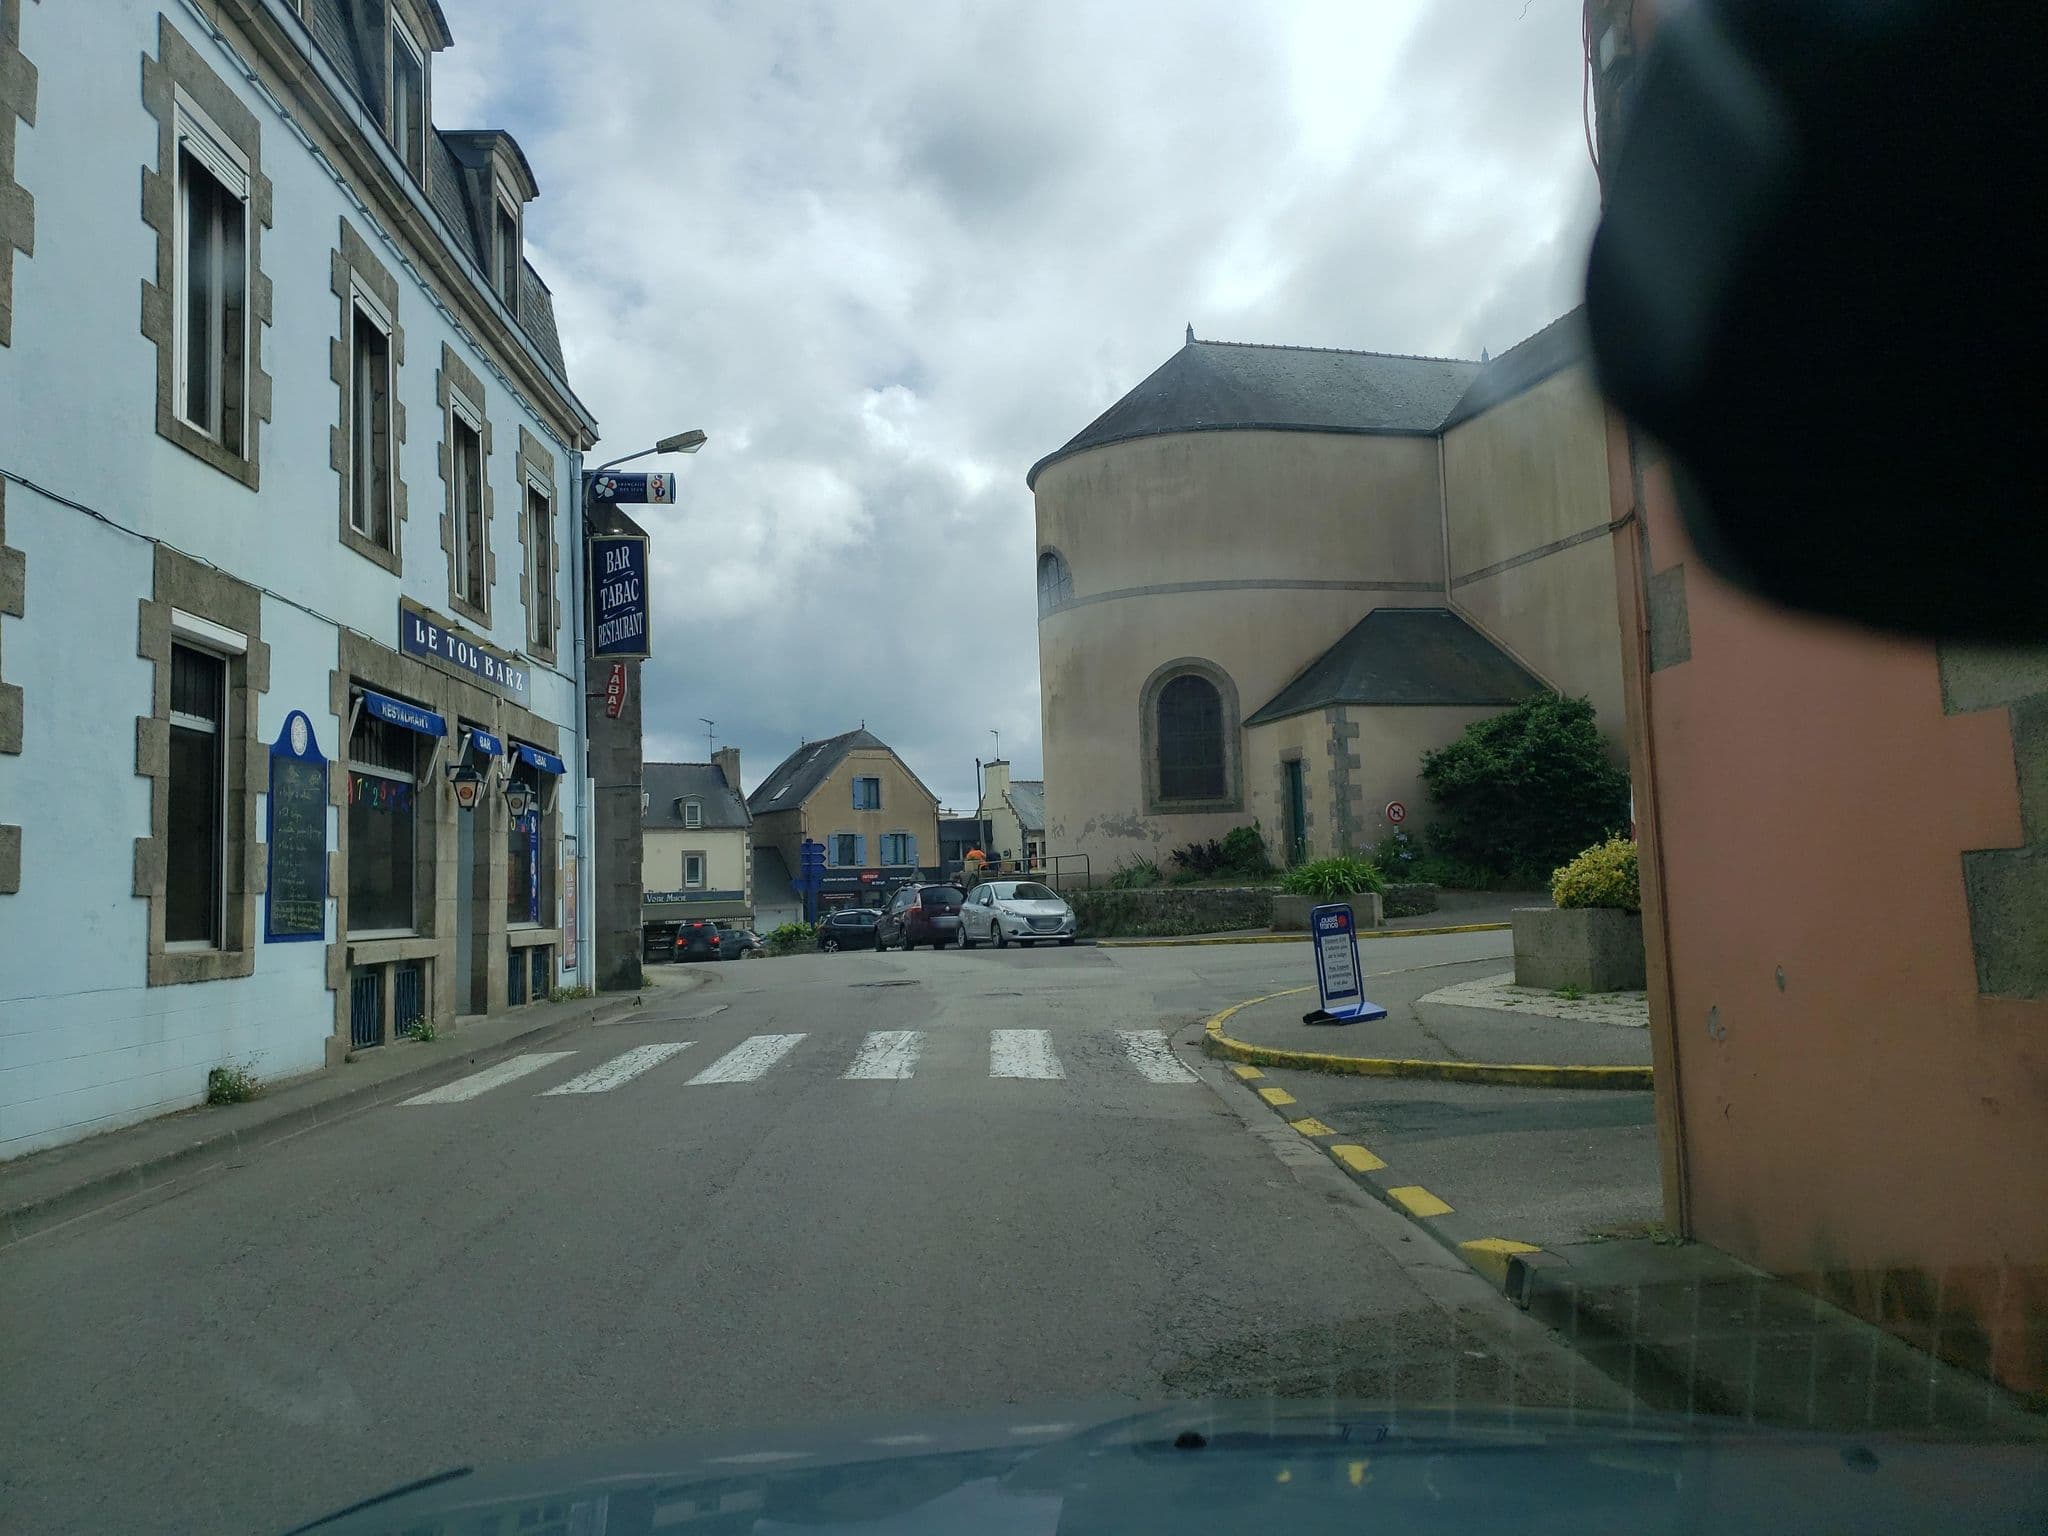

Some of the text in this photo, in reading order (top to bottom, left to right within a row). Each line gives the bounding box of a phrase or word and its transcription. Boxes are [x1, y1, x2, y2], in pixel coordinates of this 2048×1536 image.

[606, 546, 630, 573] BAR
[600, 578, 639, 611] TABAC
[598, 612, 643, 648] RESTAURANT
[415, 619, 438, 651] LE
[446, 636, 478, 669] TOL
[485, 655, 523, 691] BARZ
[607, 664, 621, 715] TABAC
[381, 704, 429, 729] RESTAURANT
[479, 736, 492, 751] BAR
